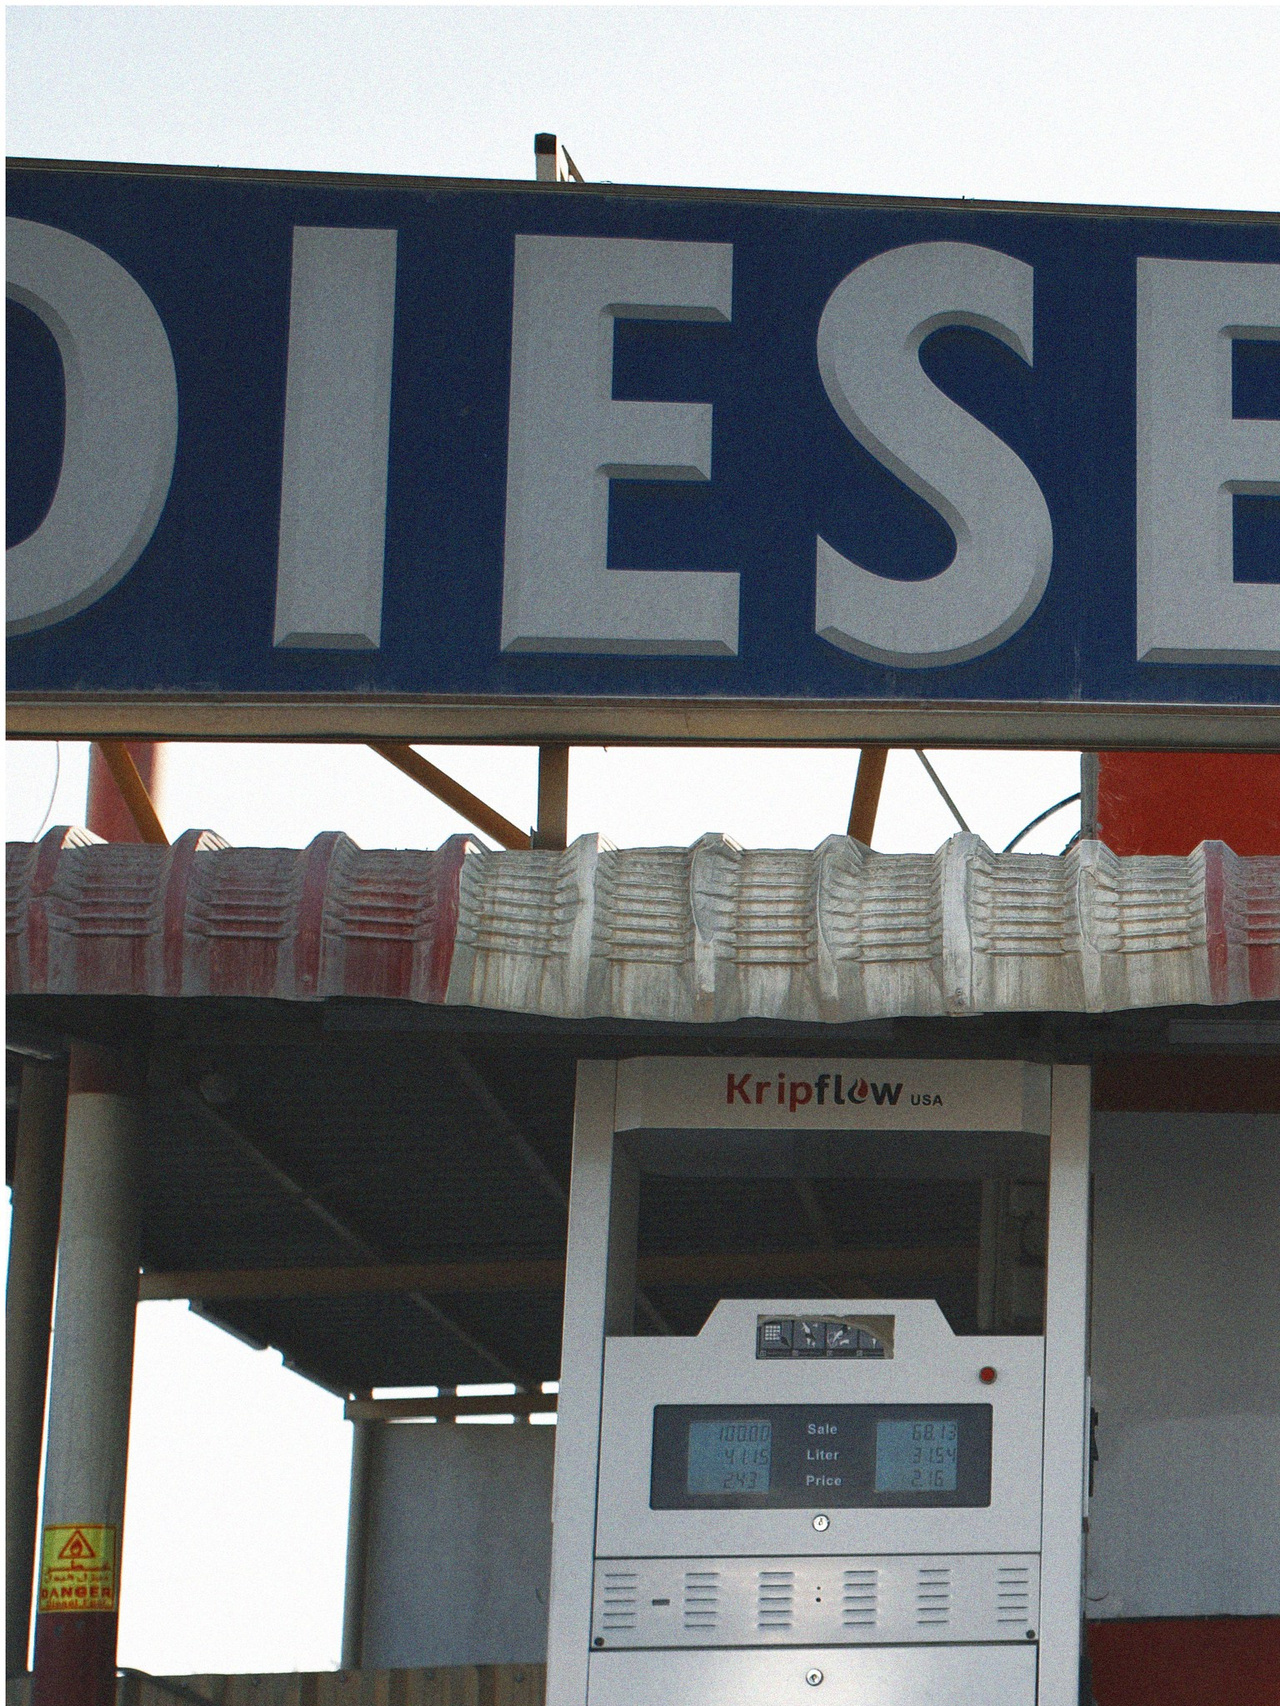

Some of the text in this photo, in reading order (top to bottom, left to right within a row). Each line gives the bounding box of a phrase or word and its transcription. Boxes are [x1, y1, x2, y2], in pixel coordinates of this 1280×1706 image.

[726, 1072, 944, 1113] Kripflow USA
[808, 1423, 838, 1435] Sale
[807, 1449, 840, 1461] Liter
[806, 1474, 842, 1487] Price
[41, 1586, 111, 1598] DANGER
